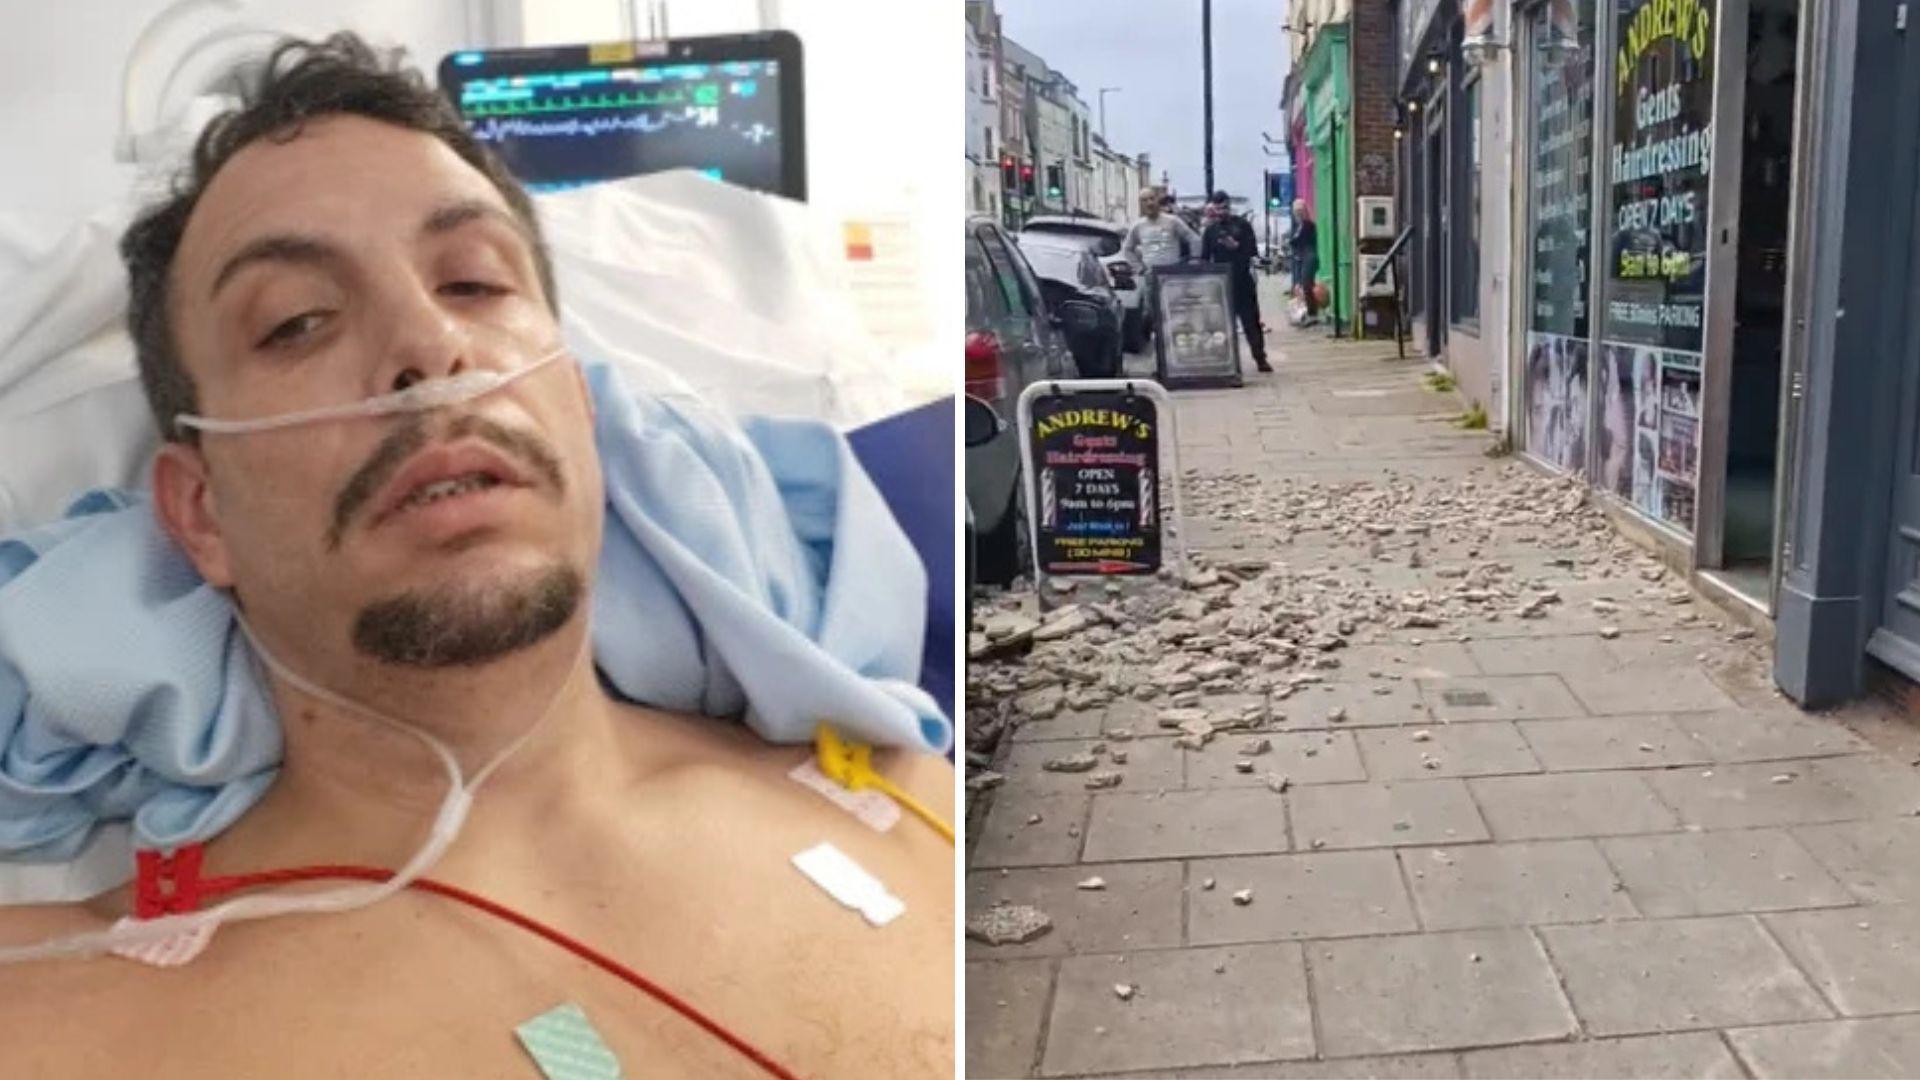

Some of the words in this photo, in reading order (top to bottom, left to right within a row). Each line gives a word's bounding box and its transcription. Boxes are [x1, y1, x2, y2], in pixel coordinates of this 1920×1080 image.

[1618, 201, 1647, 231] OPEN
[1660, 190, 1695, 226] DAYS
[1659, 304, 1700, 328] PARKING
[1037, 409, 1151, 439] ANDREW'S
[1078, 468, 1115, 480] OPEN
[1075, 484, 1083, 495] 7
[1086, 484, 1119, 495] DAYS
[1060, 498, 1087, 510] 9am
[1090, 499, 1103, 509] to
[1106, 498, 1135, 511] 6pm
[1055, 537, 1087, 546] FREE
[1088, 537, 1144, 547] PARKING
